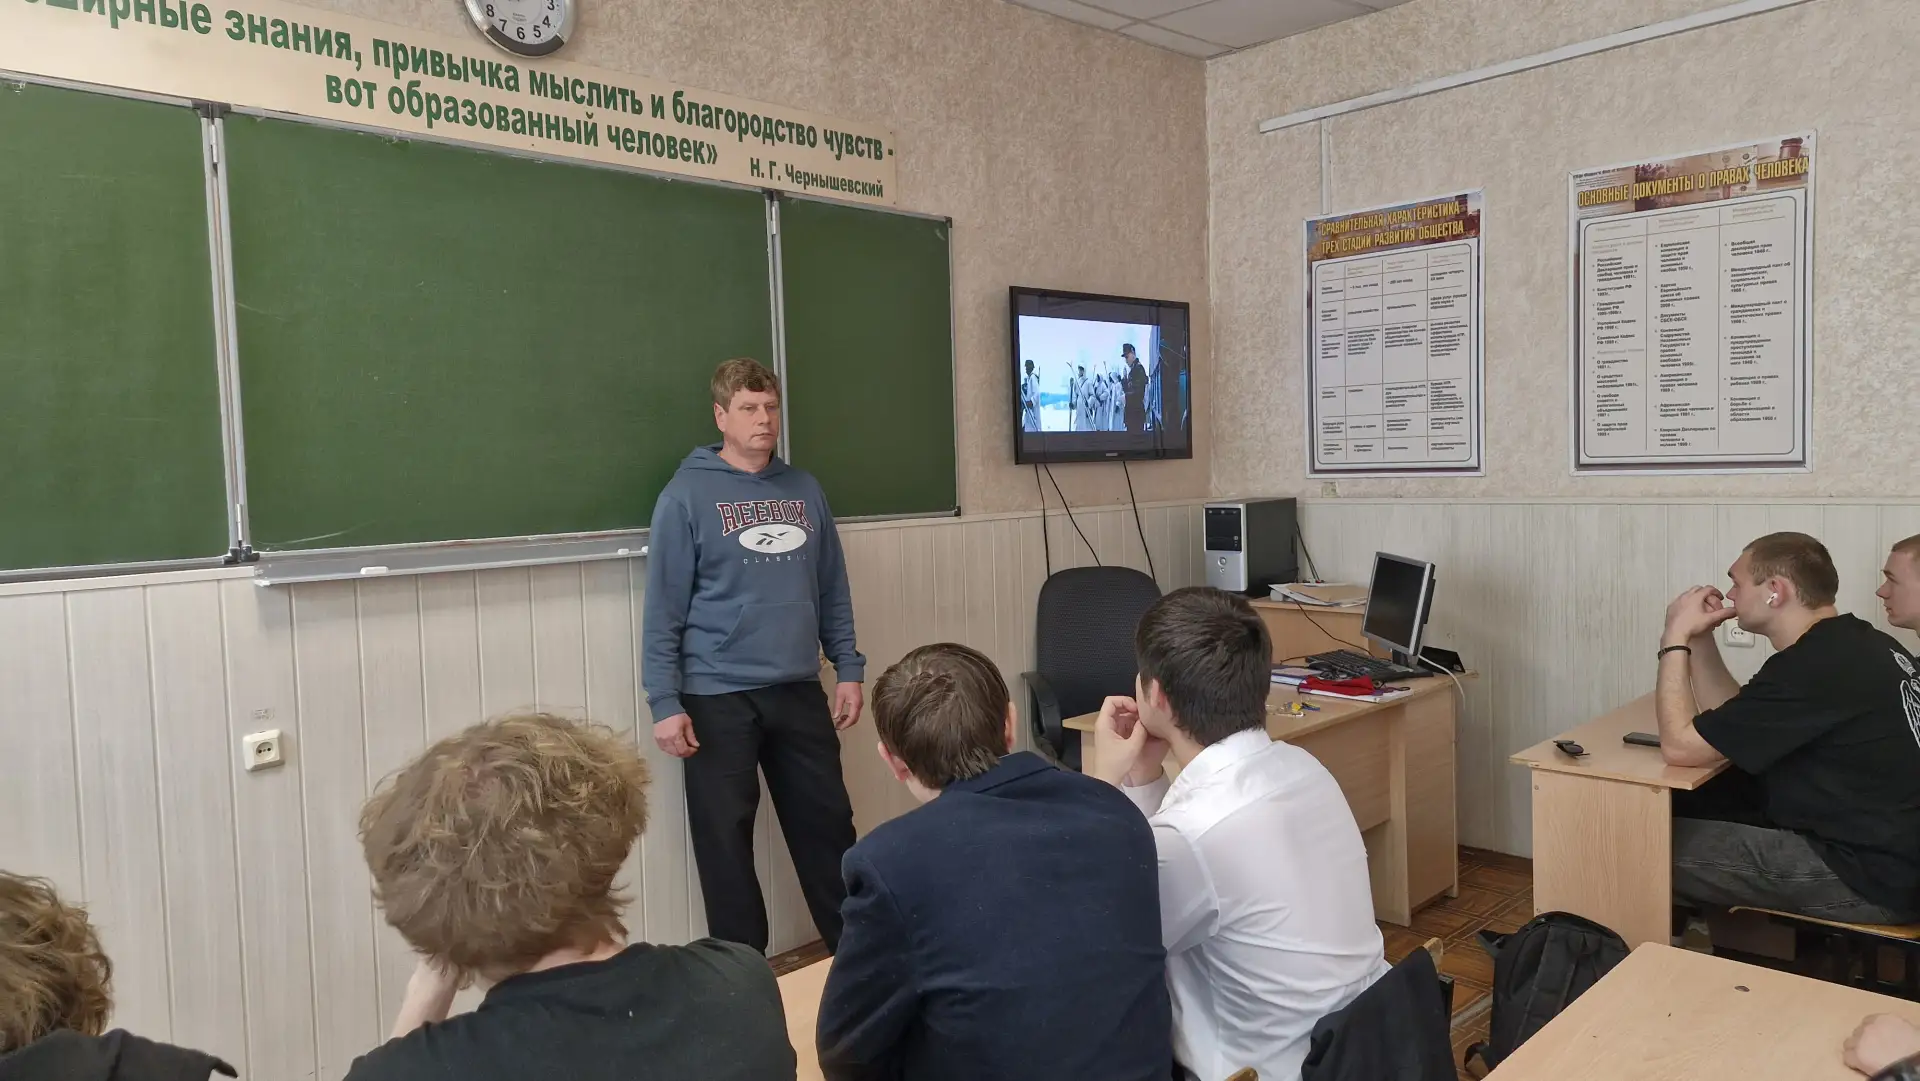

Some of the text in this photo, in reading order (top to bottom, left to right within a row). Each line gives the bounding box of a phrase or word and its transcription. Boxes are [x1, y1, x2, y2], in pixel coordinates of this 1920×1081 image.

[486, 4, 495, 17] 8
[547, 0, 556, 10] 3
[499, 19, 508, 31] 7
[533, 25, 541, 38] 5
[542, 15, 551, 28] 4
[516, 27, 525, 40] 6
[25, 0, 211, 34] ирные
[225, 11, 361, 71] знания,
[373, 38, 520, 92] привычка
[529, 69, 643, 115] мыслить
[651, 95, 665, 119] и
[673, 90, 817, 149] благородство
[823, 128, 883, 161] чувств
[326, 74, 718, 165] вот образованный человек»
[750, 157, 884, 198] Н. Г. Чернышевский
[1578, 185, 1629, 207] ОСНОВНЫЕ
[1633, 175, 1694, 201] ДОКУМЕНТЫ
[1698, 174, 1705, 188] О
[1710, 167, 1750, 187] ПРАВАХ
[1754, 156, 1810, 180] ЧЕЛОВЕКА
[1321, 201, 1460, 236] СРАВНИТЕЛЬНАЯ ХАРАКТЕРИСТИКА
[1321, 240, 1340, 254] ТРЕХ
[1374, 229, 1415, 246] РАЗВИТИЯ
[1418, 220, 1464, 240] ОБЩЕСТВА
[716, 500, 814, 536] REEBOK
[743, 554, 807, 565] CLASSIC
